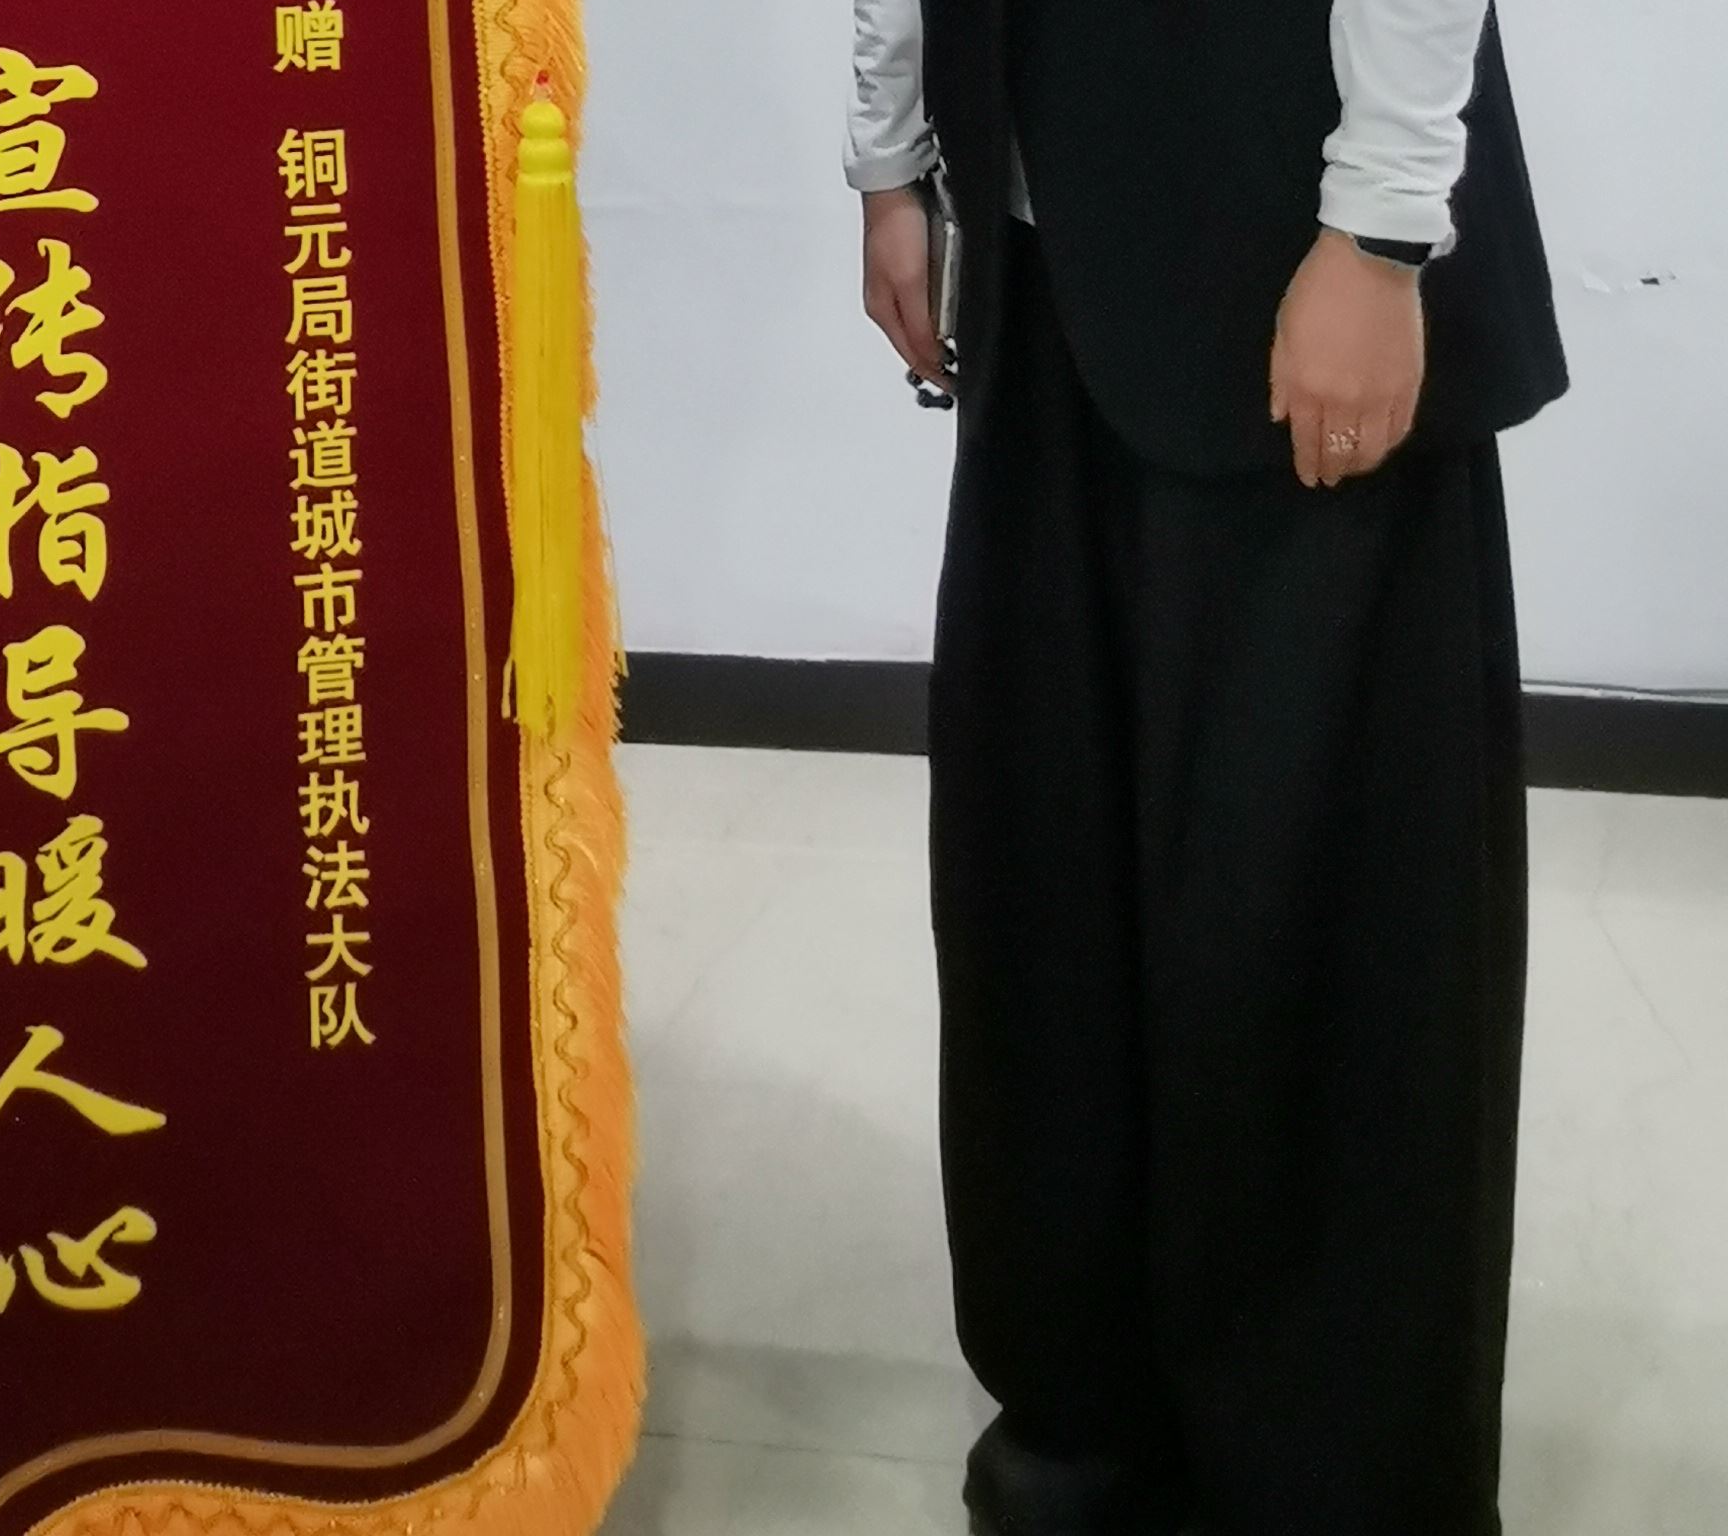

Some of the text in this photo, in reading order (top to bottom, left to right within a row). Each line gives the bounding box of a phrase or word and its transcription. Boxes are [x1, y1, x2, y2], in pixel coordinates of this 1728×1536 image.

[276, 128, 377, 1049] 铜元局街道城市管理执法大队
